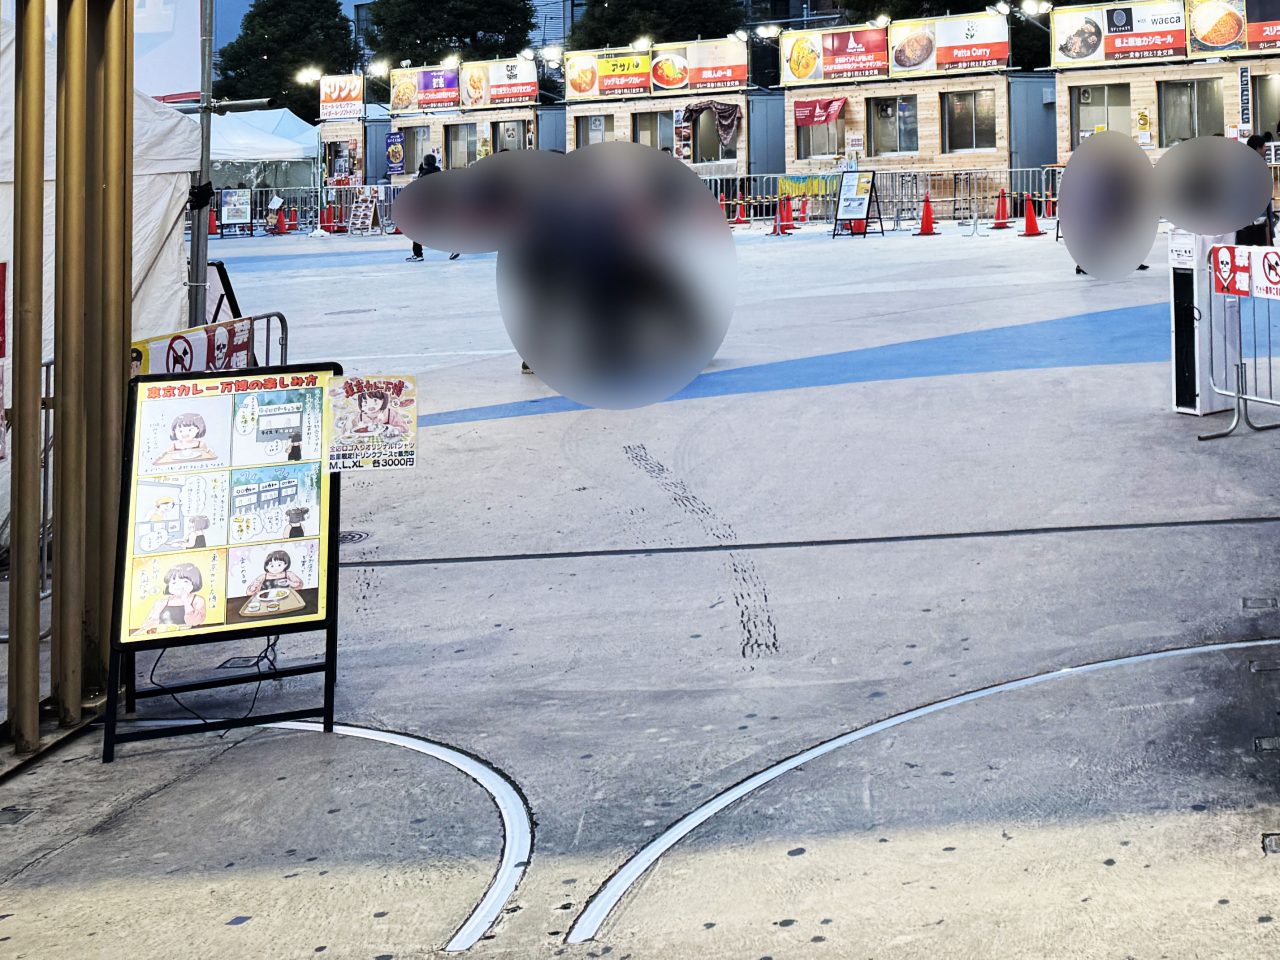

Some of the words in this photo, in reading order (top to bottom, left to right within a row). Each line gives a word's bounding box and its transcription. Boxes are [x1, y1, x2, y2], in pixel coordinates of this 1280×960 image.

[147, 374, 318, 399] 東京カレー万博の楽しみ方
